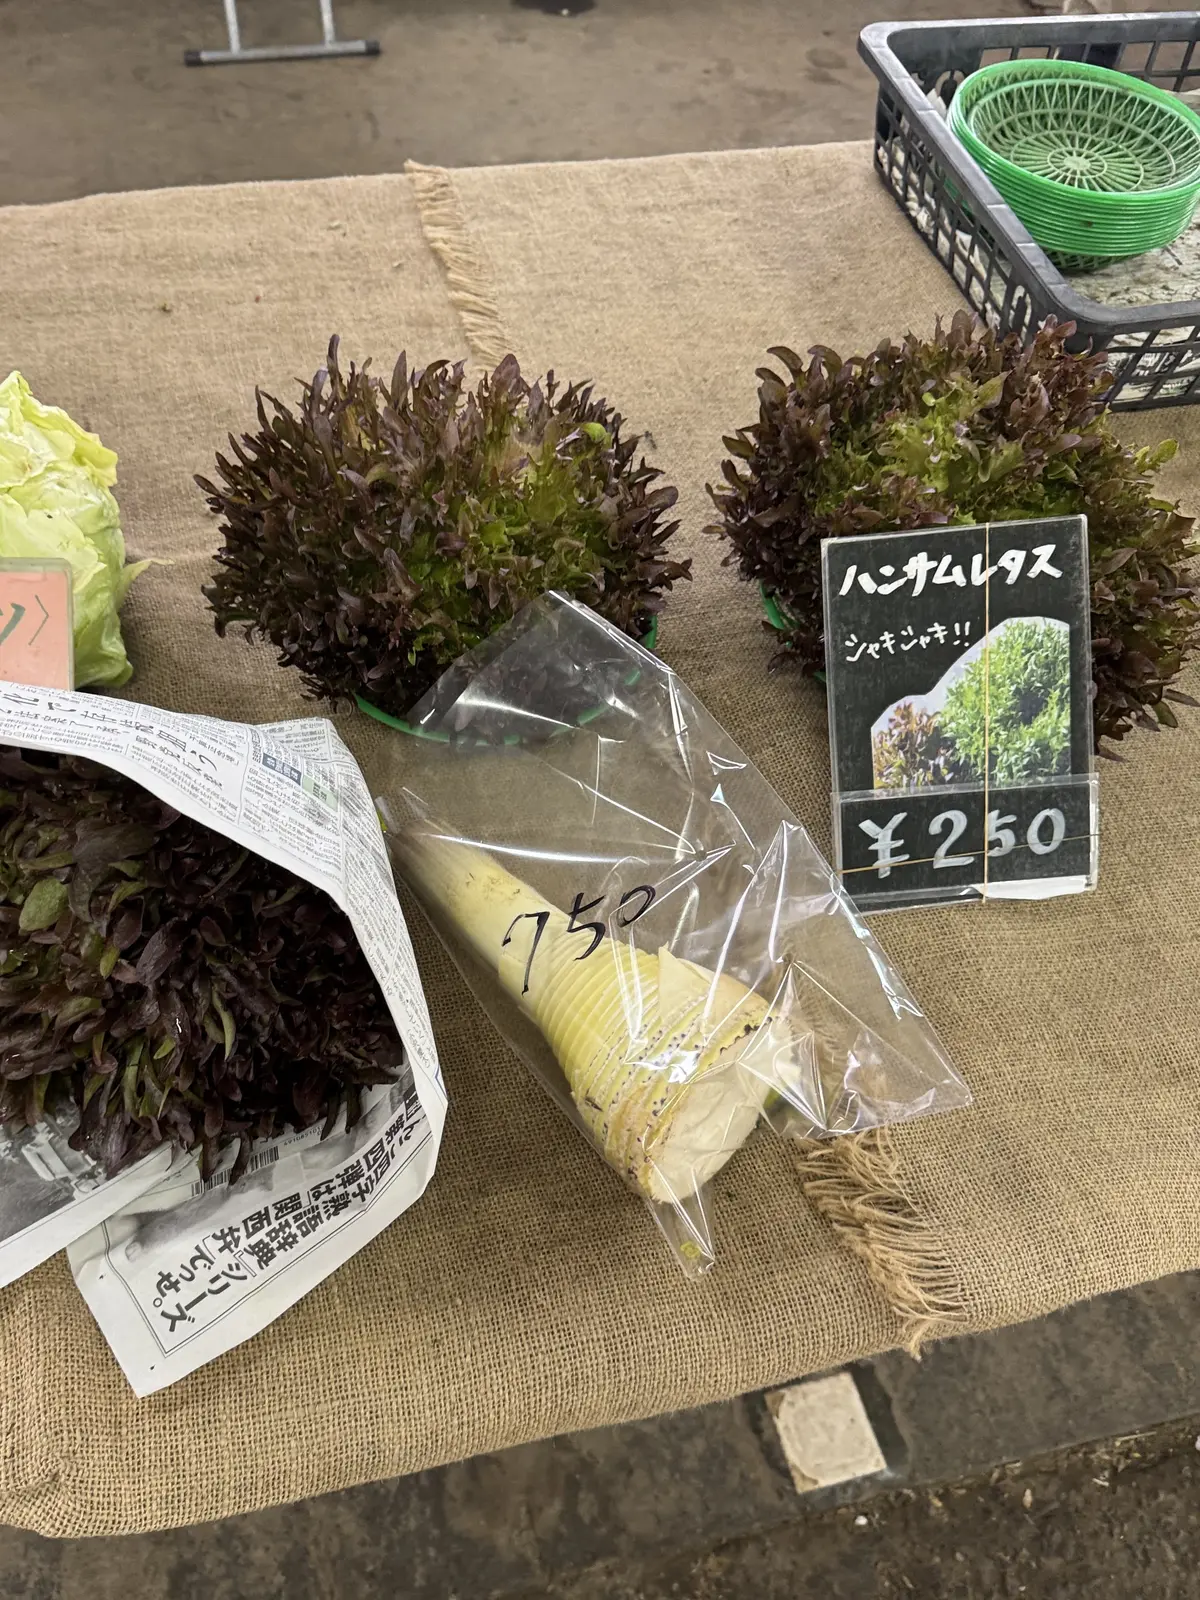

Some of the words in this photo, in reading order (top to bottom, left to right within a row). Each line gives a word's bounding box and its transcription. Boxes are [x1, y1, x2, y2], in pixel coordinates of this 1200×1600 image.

[839, 544, 1064, 597] ハンサムレタス
[858, 807, 1066, 879] ¥250
[502, 884, 656, 996] 750
[161, 1114, 426, 1332] んこ四字熟語辞典』シリーズ
